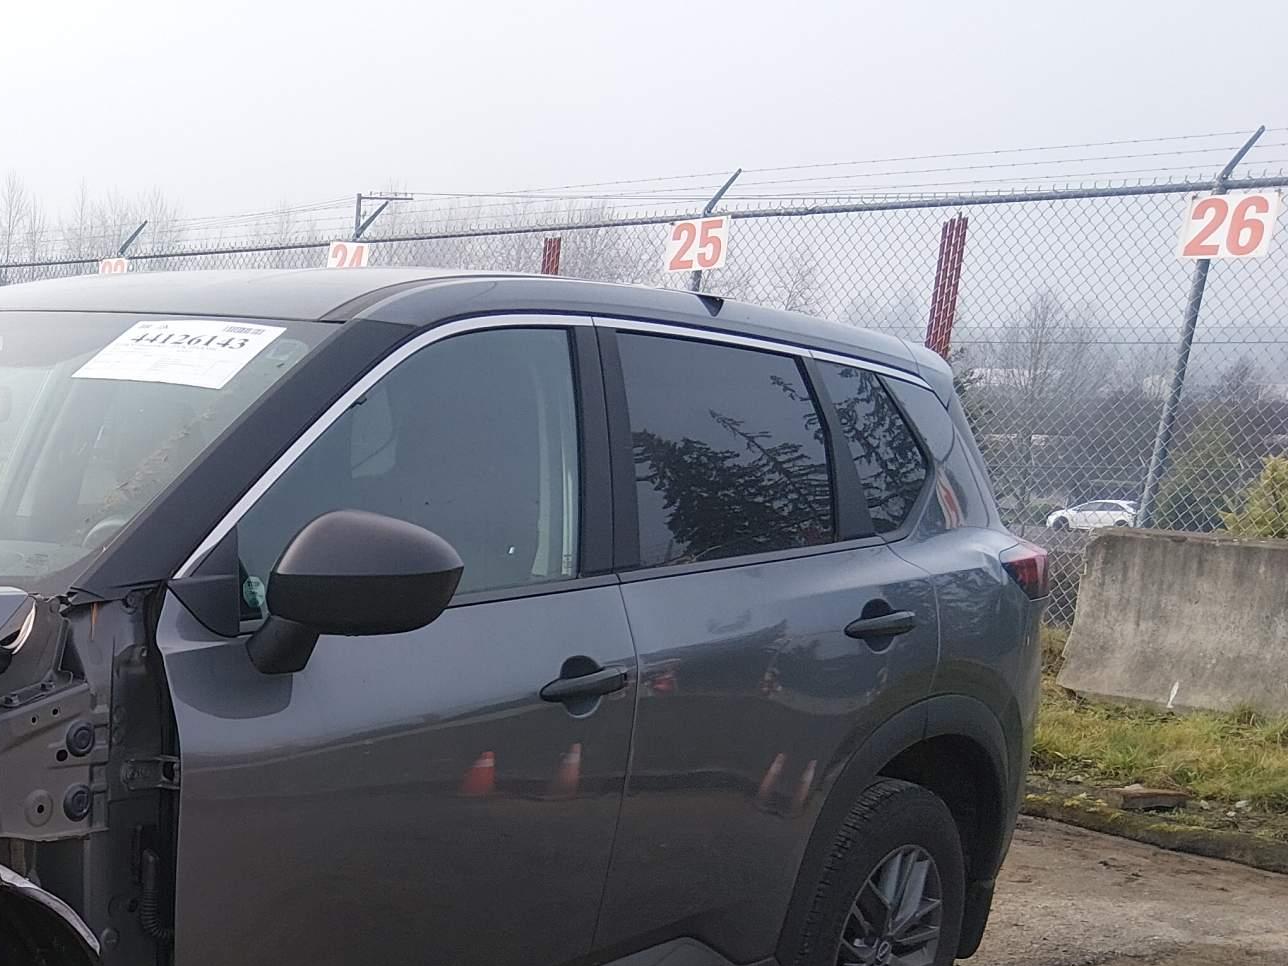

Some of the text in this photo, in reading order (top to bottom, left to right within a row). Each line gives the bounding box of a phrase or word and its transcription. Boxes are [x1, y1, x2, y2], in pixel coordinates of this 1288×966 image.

[669, 219, 724, 270] 25
[1184, 195, 1267, 256] 26
[130, 332, 250, 350] 44126143
